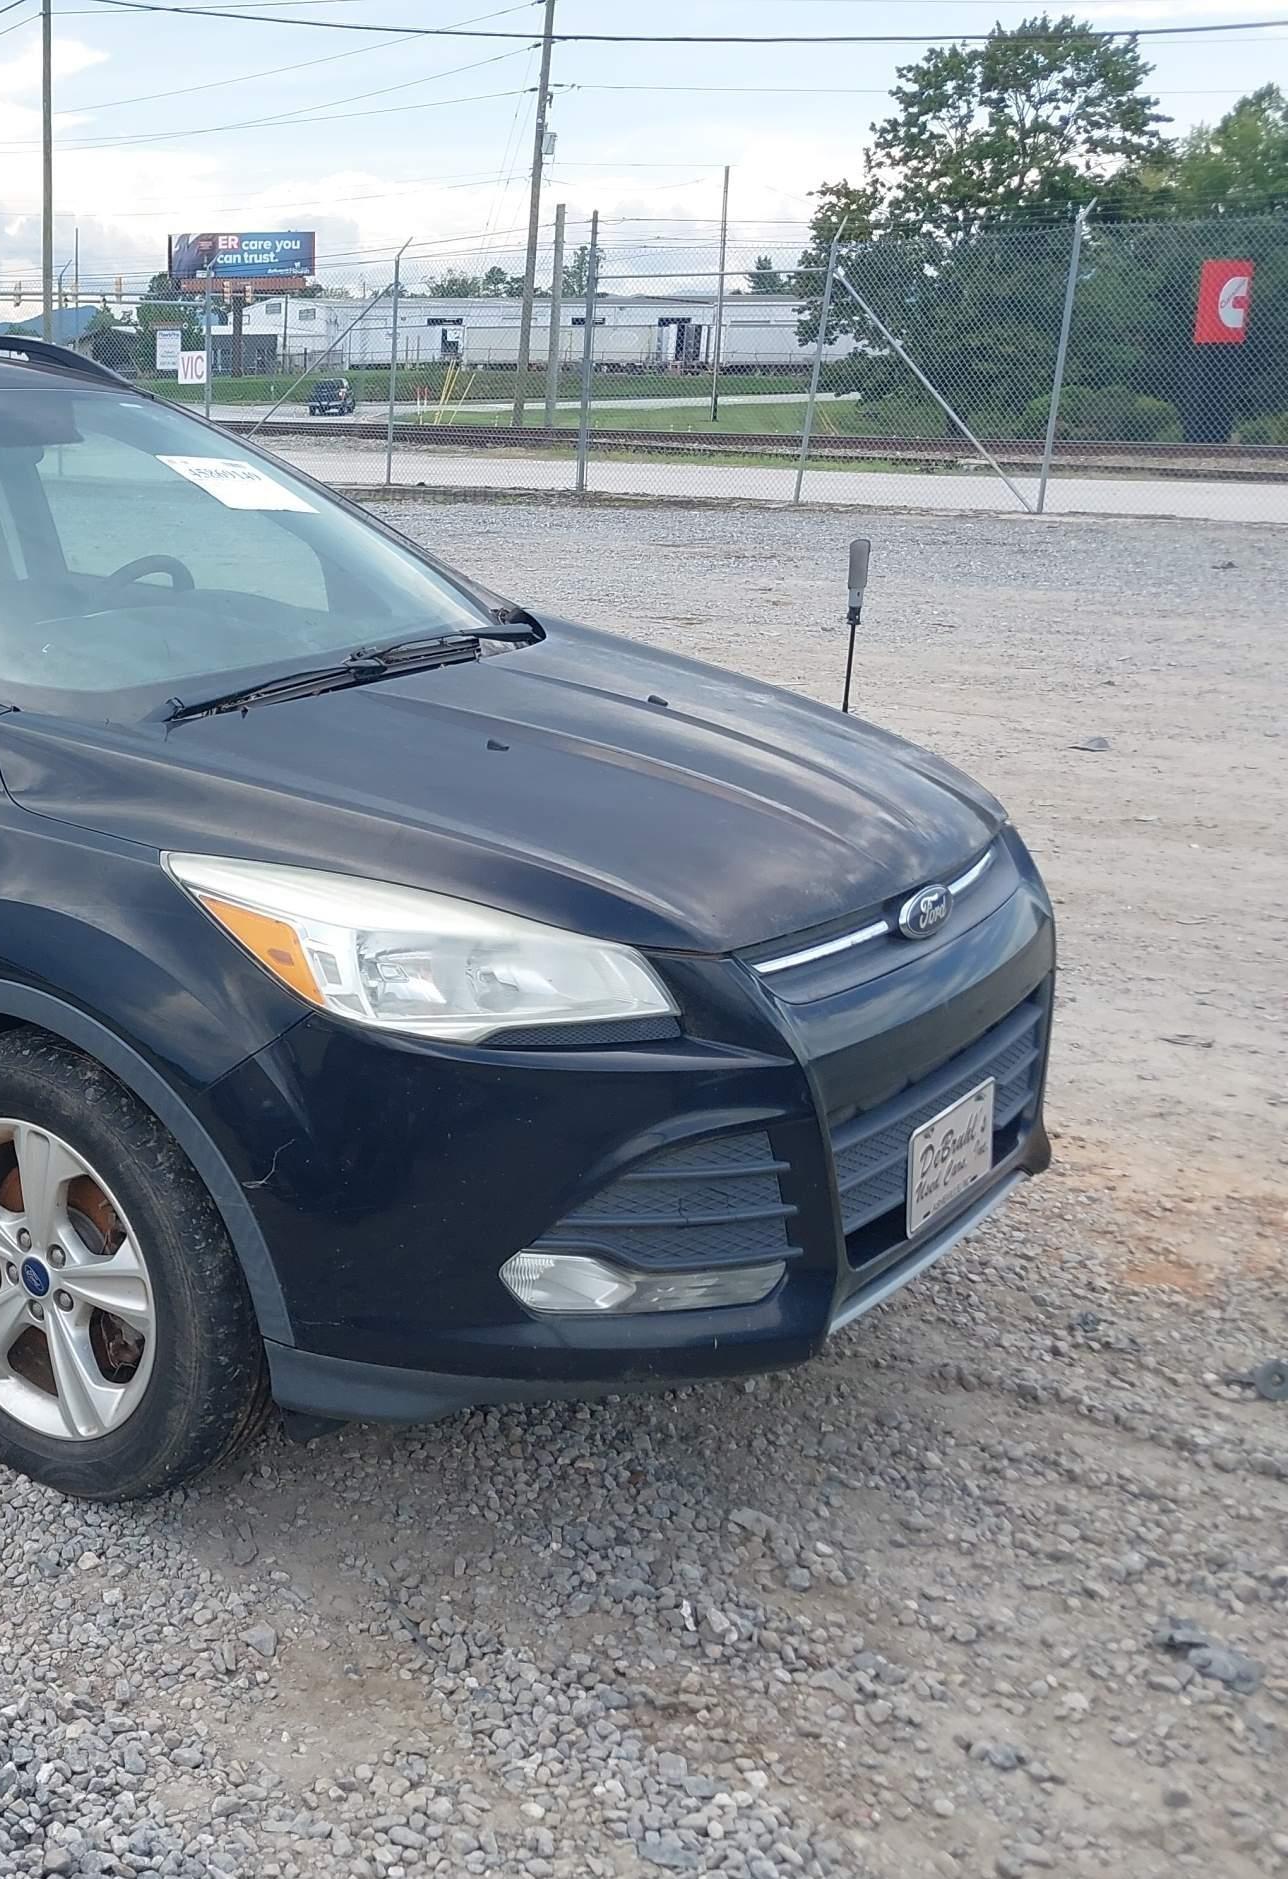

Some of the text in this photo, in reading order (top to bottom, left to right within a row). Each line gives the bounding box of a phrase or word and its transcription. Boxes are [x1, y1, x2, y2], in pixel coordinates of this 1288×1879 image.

[218, 235, 238, 249] ER
[242, 240, 271, 250] care
[275, 239, 300, 252] you
[217, 251, 279, 264] can trust.
[182, 355, 204, 380] VIC
[919, 892, 946, 929] Ford
[915, 1170, 941, 1204] Used
